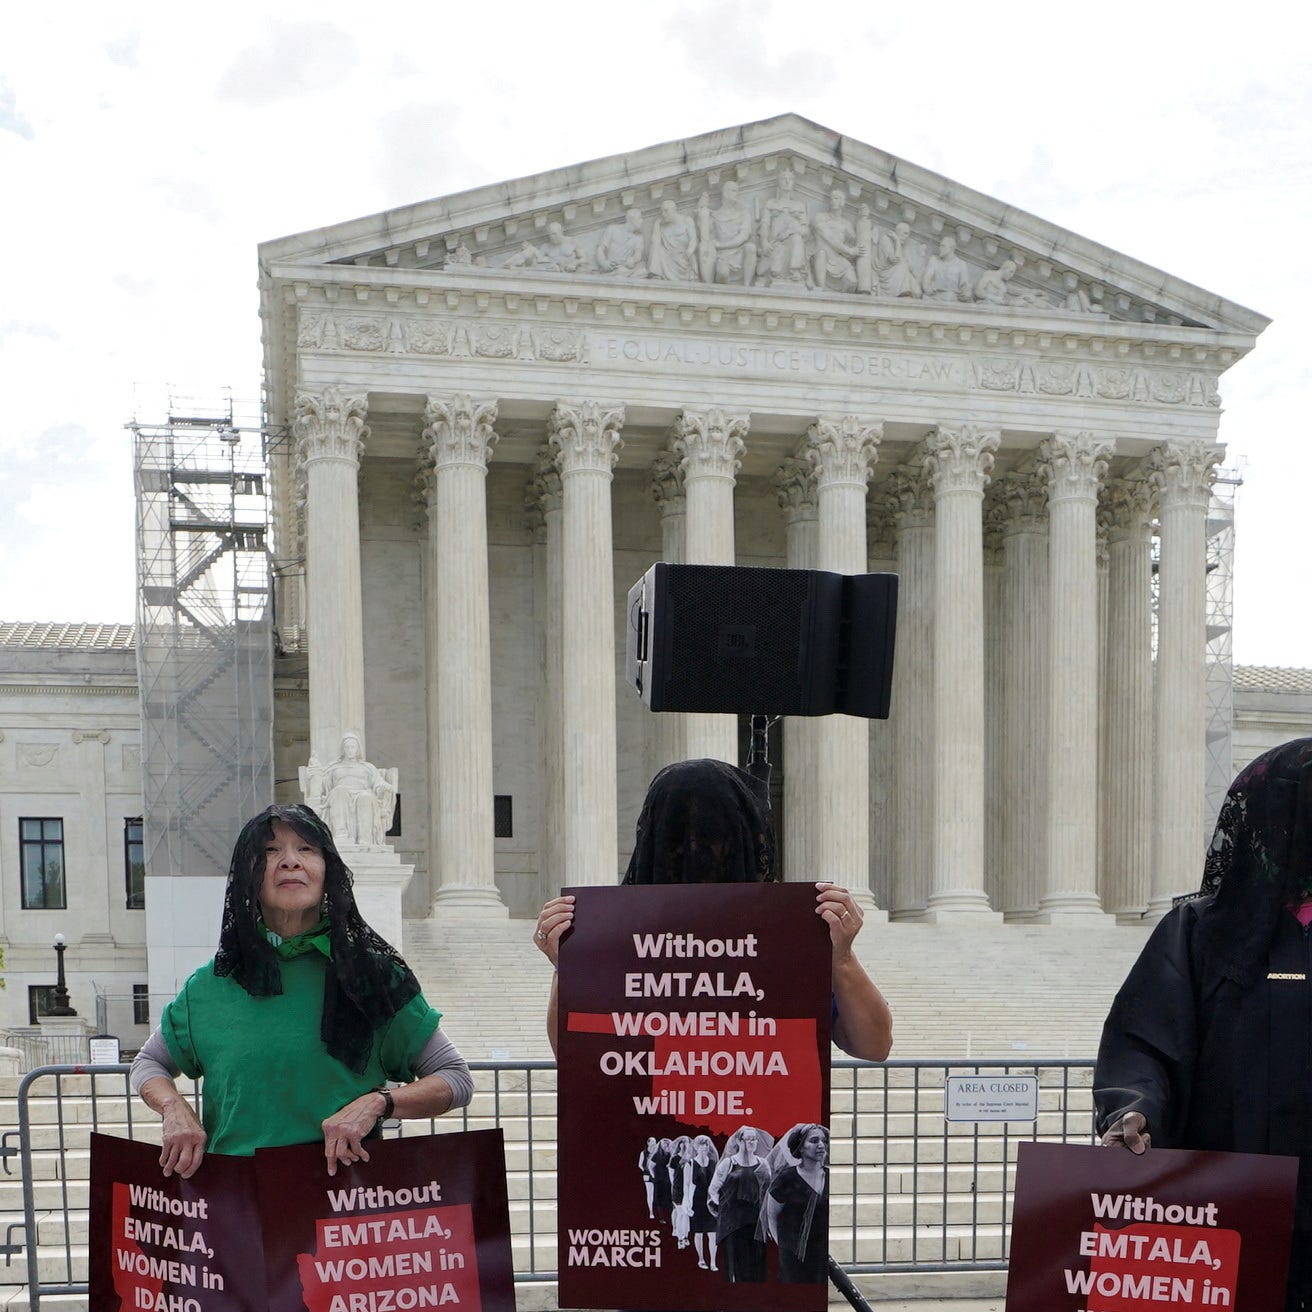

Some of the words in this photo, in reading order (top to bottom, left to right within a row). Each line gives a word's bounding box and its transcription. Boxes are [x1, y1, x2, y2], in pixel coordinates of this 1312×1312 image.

[607, 339, 694, 363] EQUAL
[702, 343, 800, 371] JUSTICE
[813, 352, 894, 377] UNDER
[907, 359, 953, 380] LAW
[633, 933, 757, 957] Without
[626, 972, 764, 1001] EMTALA,
[612, 1012, 739, 1036] WOMEN
[749, 1011, 776, 1035] in
[600, 1051, 788, 1075] OKLAHOMA
[633, 1090, 685, 1114] will
[695, 1091, 752, 1115] DIE.
[958, 1084, 986, 1093] AREA
[990, 1083, 1029, 1093] CLOSED
[129, 1183, 208, 1220] Without
[327, 1181, 441, 1212] Without
[1091, 1193, 1218, 1226] Without
[124, 1217, 215, 1259] EMTALA,
[324, 1215, 451, 1247] EMTALA,
[568, 1230, 660, 1246] WOMEN'S
[315, 1251, 432, 1282] WOMEN
[440, 1249, 464, 1270] in
[568, 1246, 660, 1267] MARCH
[1080, 1232, 1221, 1270] EMTALA,
[117, 1249, 196, 1286] WOMEN
[203, 1266, 223, 1290] in
[1064, 1269, 1194, 1302] WOMEN
[1202, 1279, 1229, 1305] in
